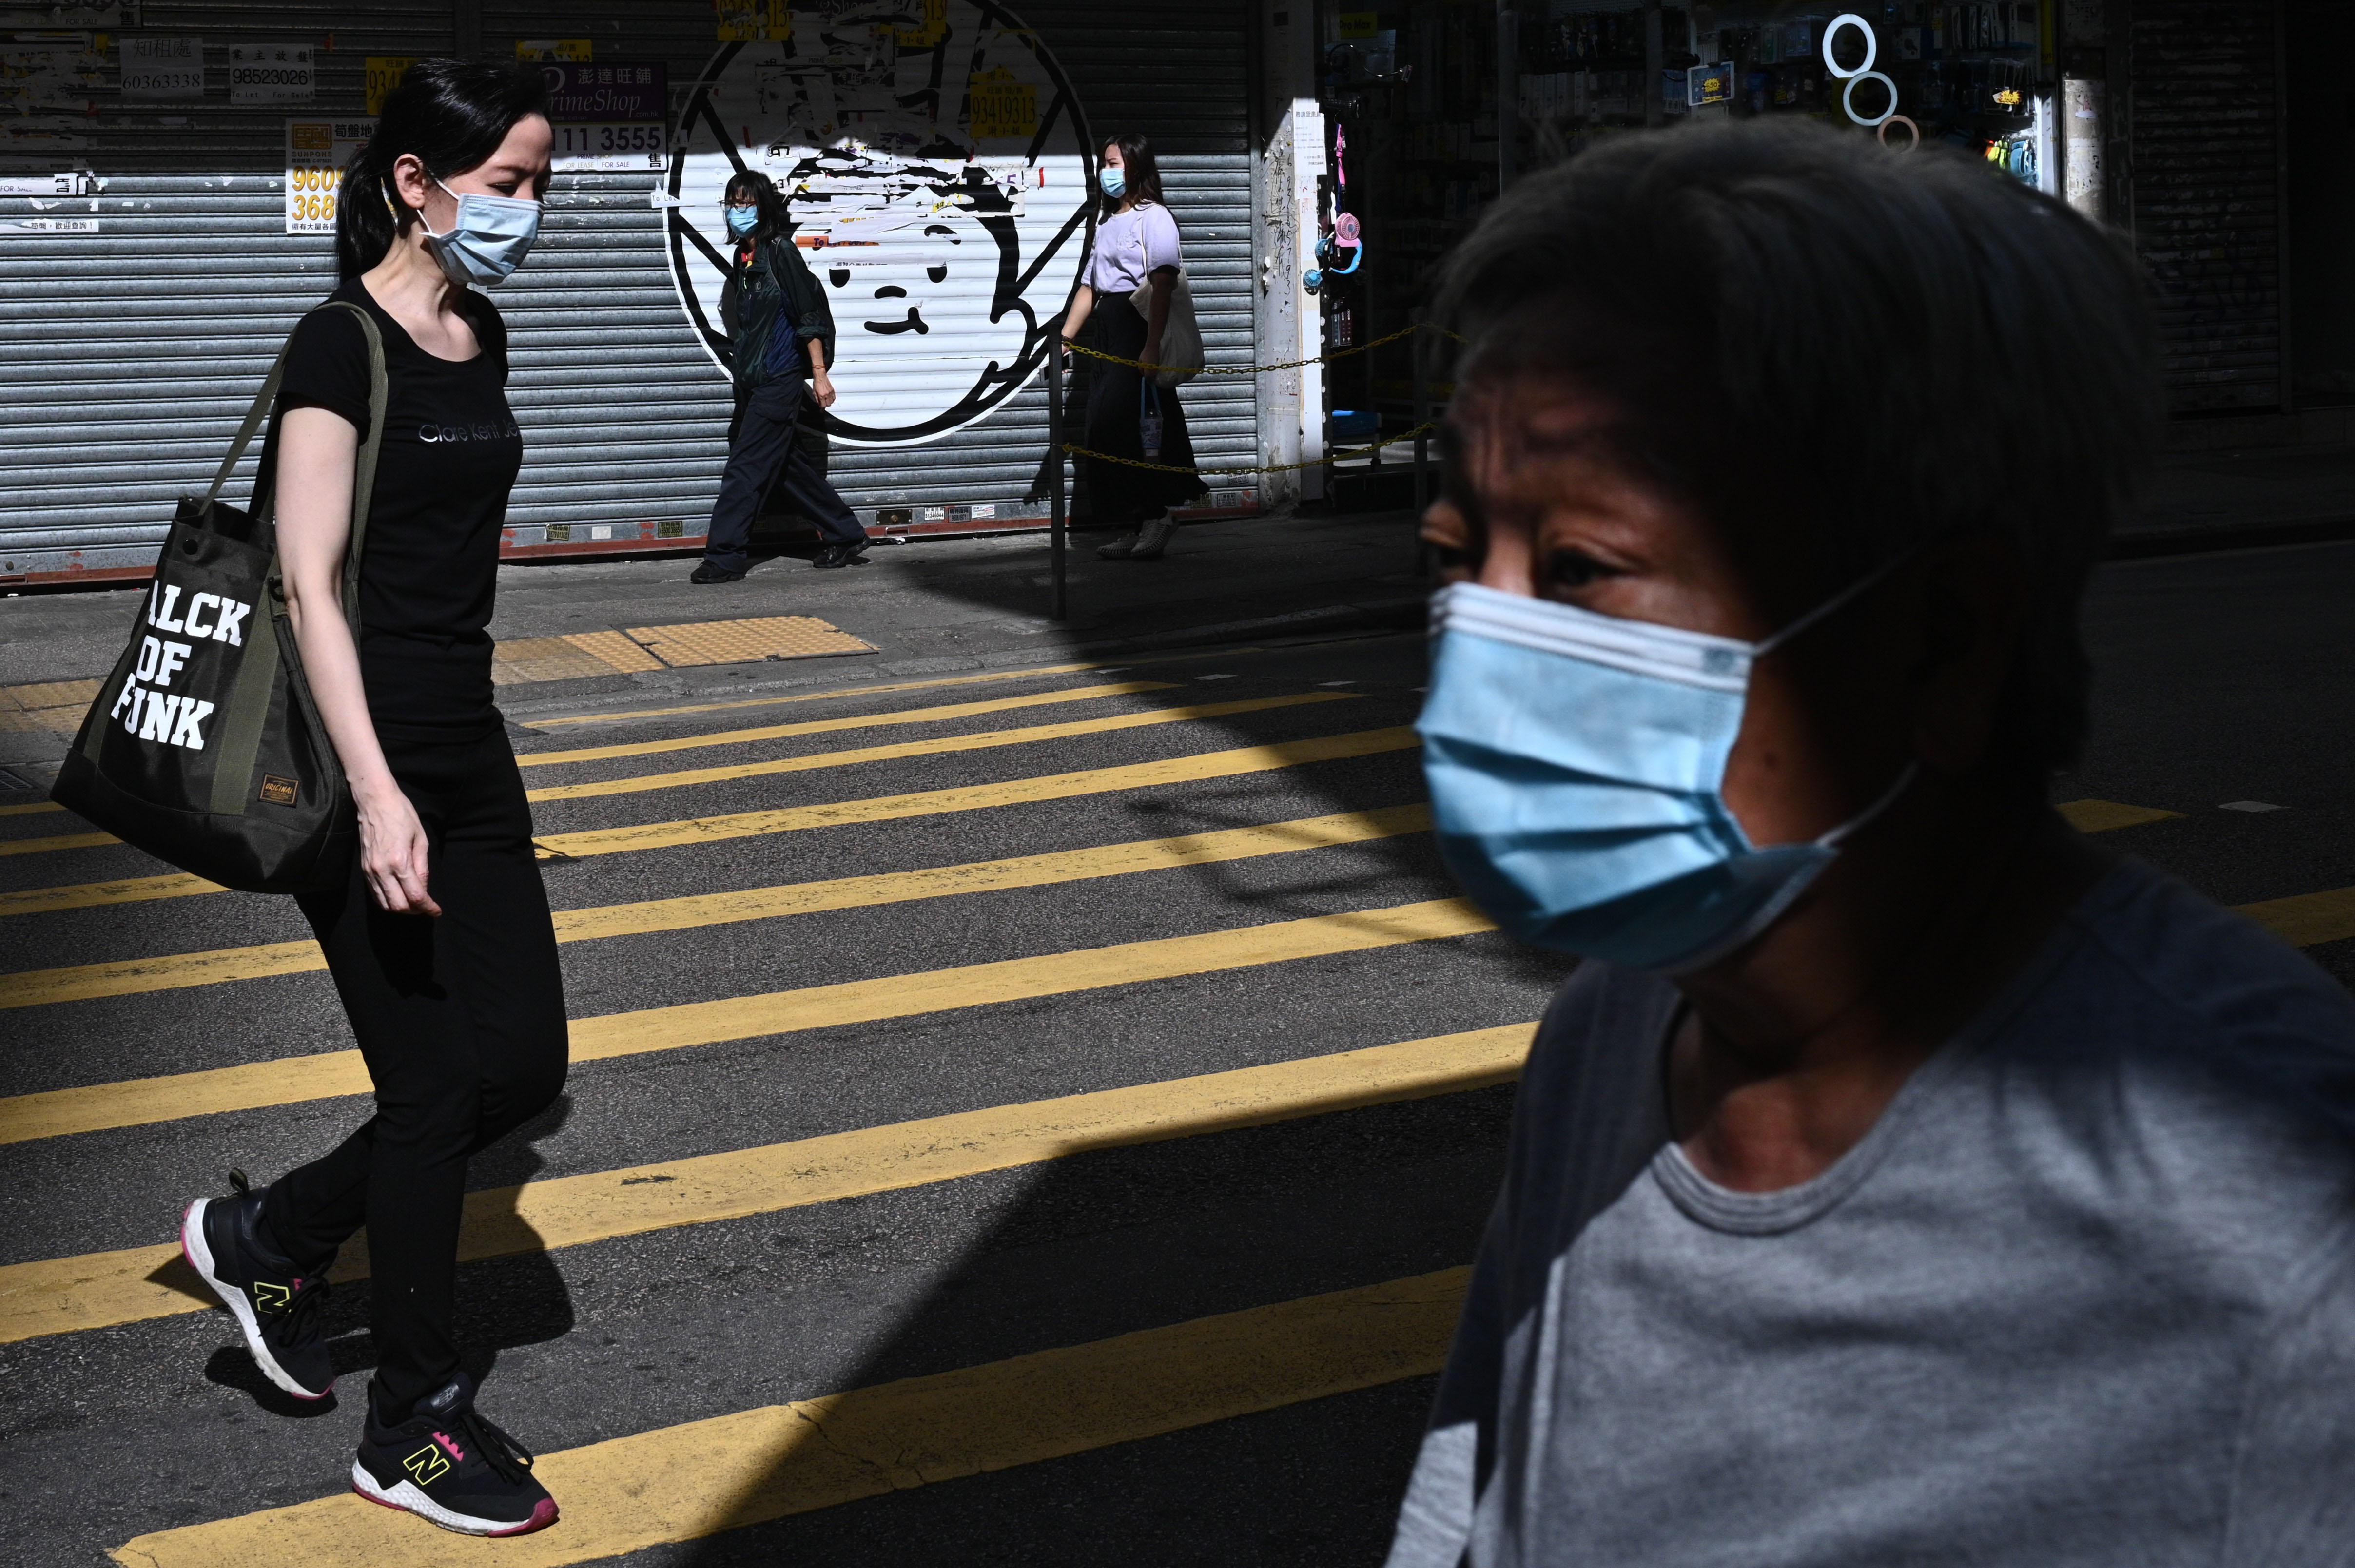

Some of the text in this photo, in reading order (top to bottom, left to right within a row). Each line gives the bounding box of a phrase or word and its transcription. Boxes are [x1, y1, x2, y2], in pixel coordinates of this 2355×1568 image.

[120, 11, 134, 25] 售
[133, 39, 192, 58] 知租處
[123, 74, 200, 89] 60363338
[233, 69, 308, 85] 98523026
[578, 67, 651, 84] 澎達旺舖
[550, 90, 641, 118] rimeShop
[972, 97, 1036, 125] 93419313
[600, 127, 661, 151] 3555
[648, 153, 661, 168] 售
[419, 423, 468, 442] Clare
[467, 421, 500, 441] Kent
[136, 635, 192, 686] OF
[111, 673, 215, 750] FUNK
[403, 1443, 451, 1486] N
